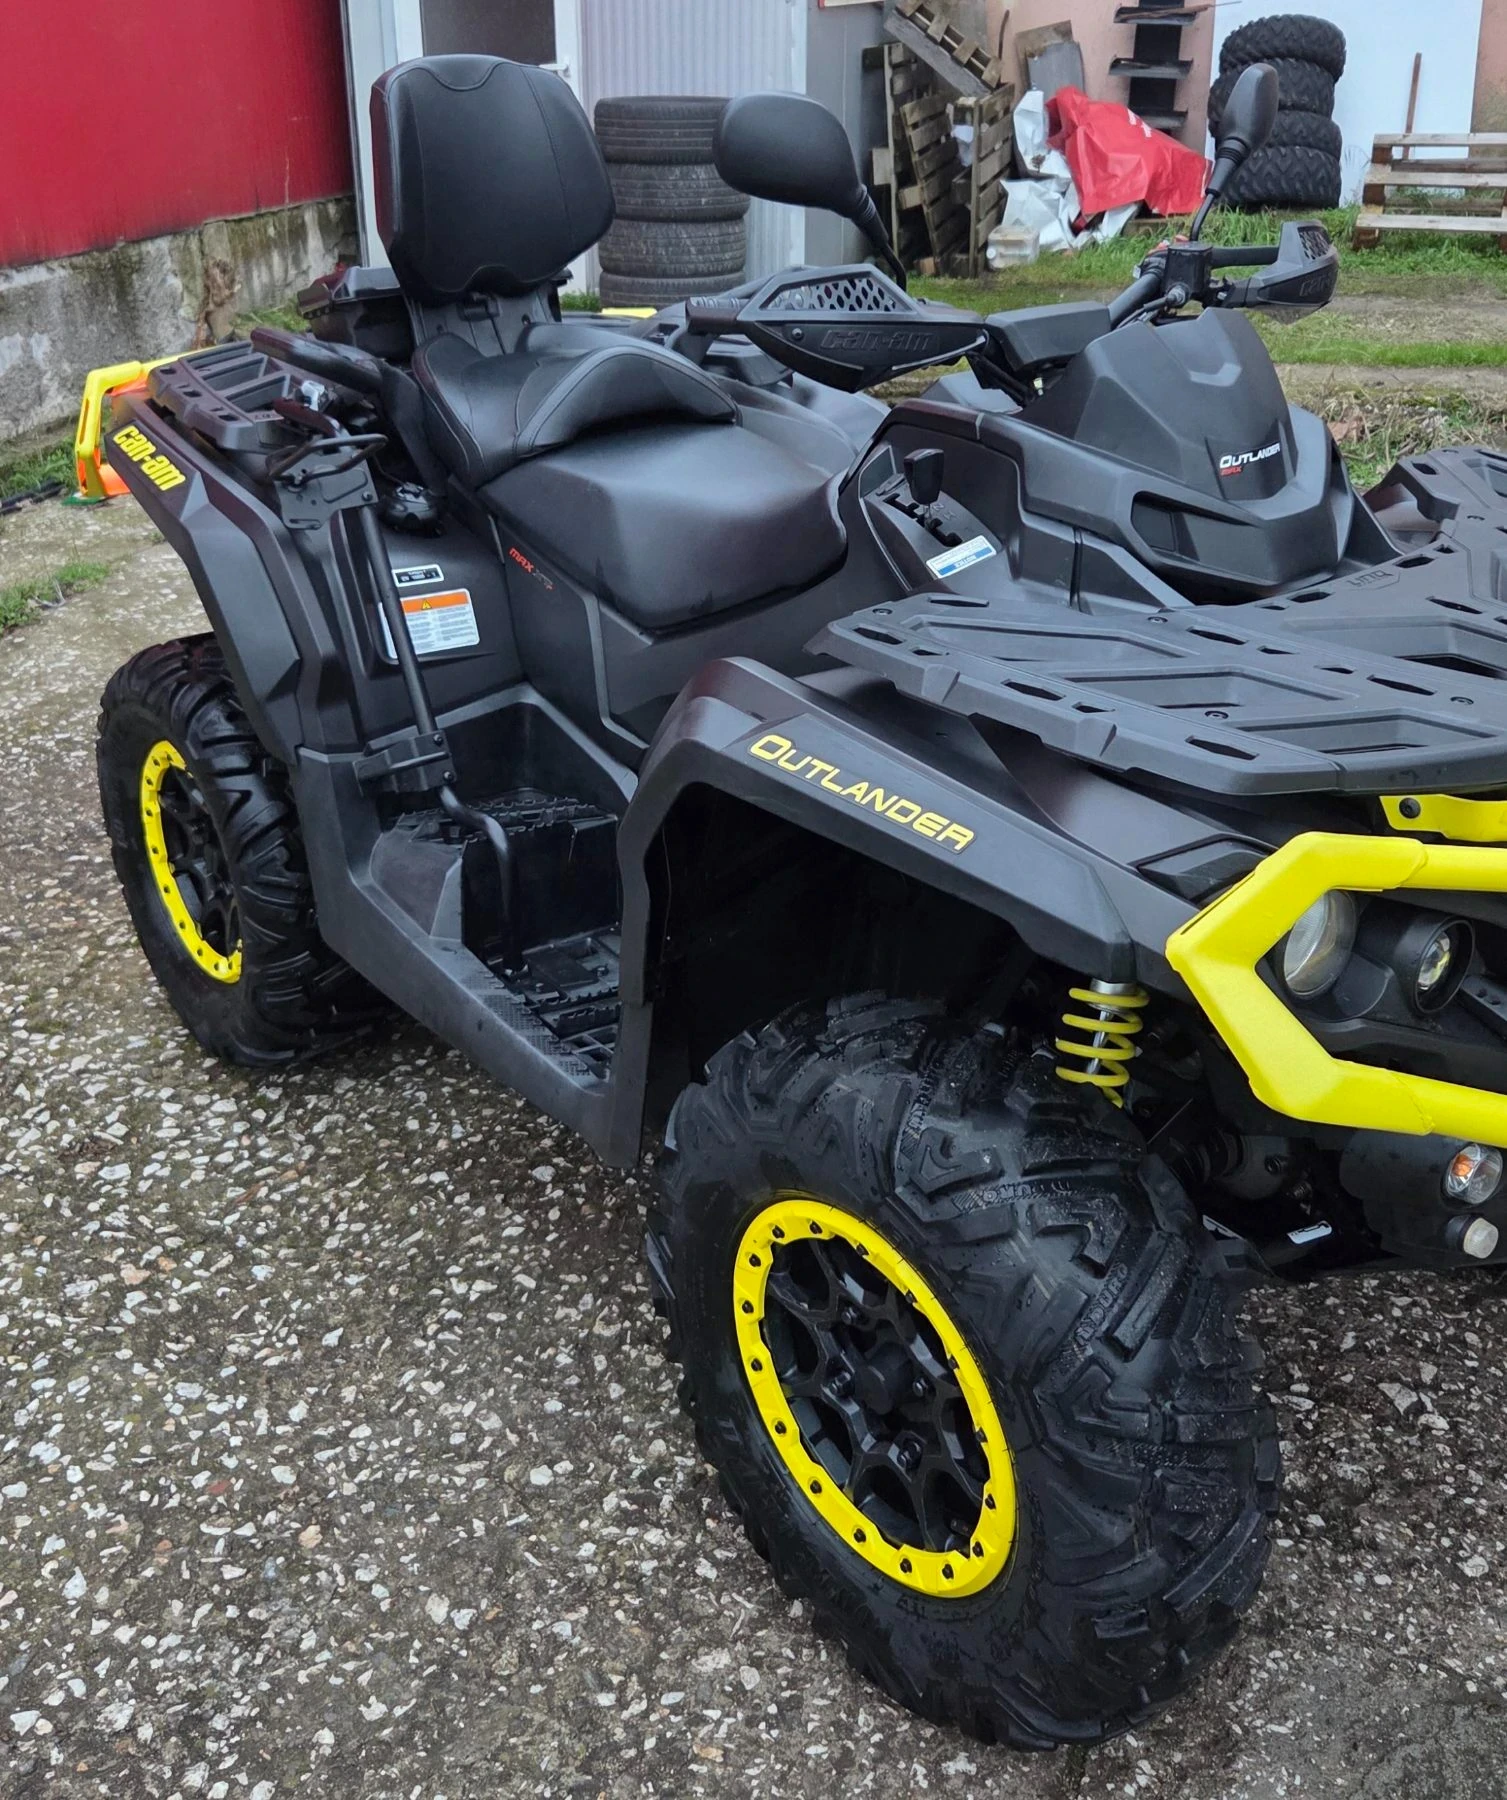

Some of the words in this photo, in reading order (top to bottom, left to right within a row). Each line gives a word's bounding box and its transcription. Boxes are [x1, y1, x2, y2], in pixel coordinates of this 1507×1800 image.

[113, 425, 187, 491] can-am
[1219, 443, 1281, 469] OUTLANDER
[509, 547, 535, 573] MAX
[749, 733, 976, 852] OUTLANDER
